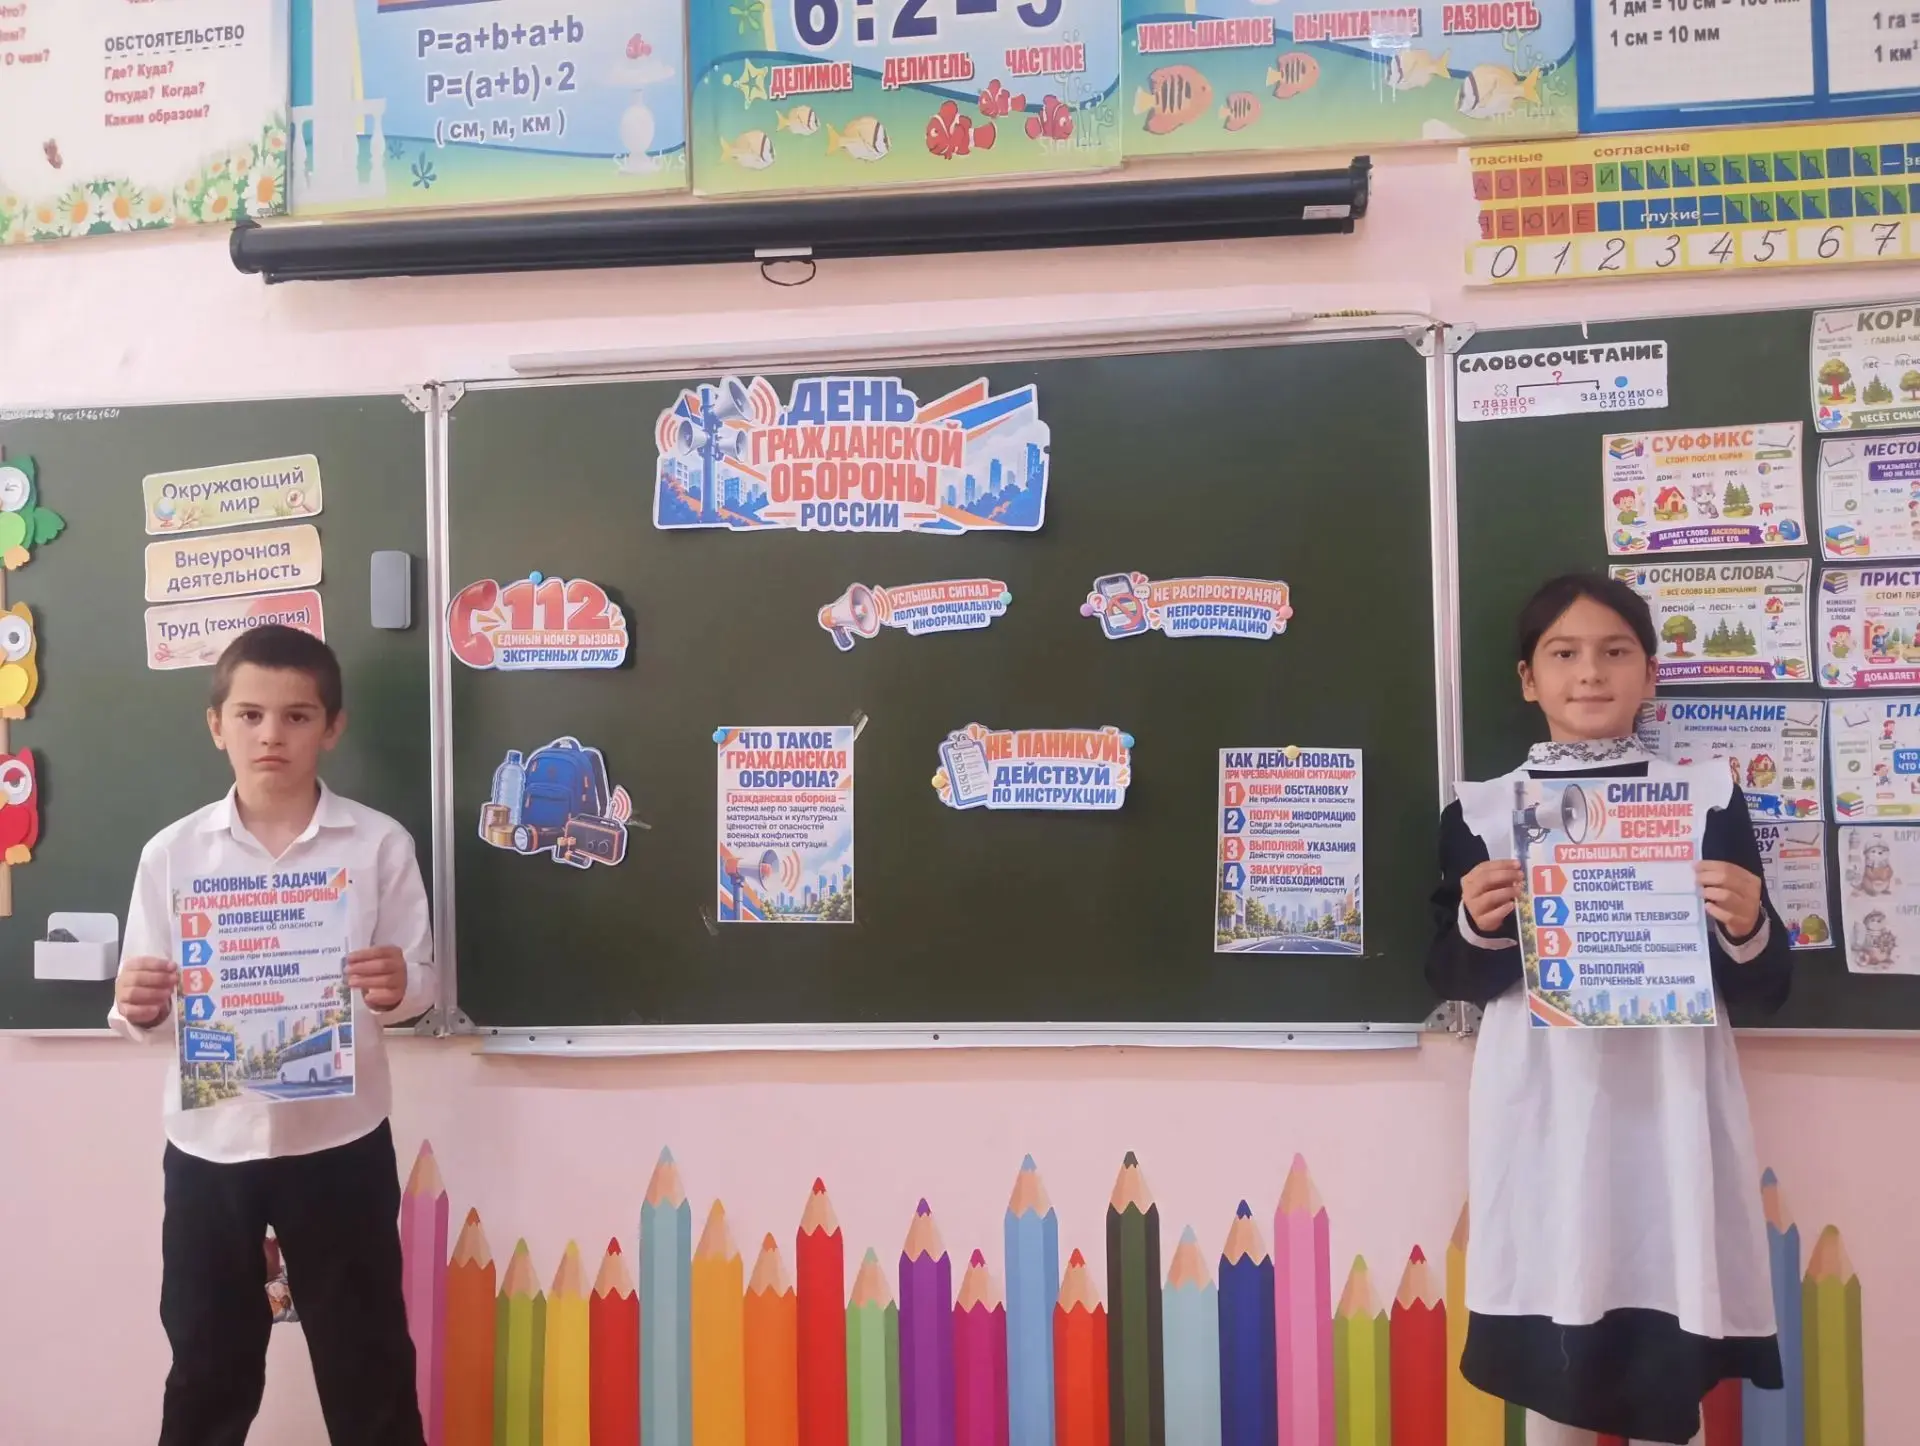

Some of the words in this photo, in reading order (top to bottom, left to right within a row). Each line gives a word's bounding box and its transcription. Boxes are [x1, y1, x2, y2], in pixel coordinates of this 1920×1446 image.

[1138, 18, 1273, 52] УМЕНЬШАЕМОЕ
[1442, 2, 1539, 33] РАЗНОСТЬ
[1873, 12, 1881, 30] 1
[105, 24, 244, 52] ОБСТОЯТЕЛЬСТВО
[1610, 30, 1618, 46] 1
[1625, 32, 1648, 46] см
[1669, 26, 1688, 43] 10
[1695, 28, 1720, 42] мм
[1874, 45, 1883, 62] 1
[104, 66, 133, 79] Где?
[137, 61, 174, 78] Куда?
[770, 62, 852, 96] ДЕЛИМОЕ
[883, 52, 973, 88] ДЕЛИТЕЛЬ
[1005, 45, 1084, 74] ЧАСТНОЕ
[104, 87, 155, 104] Откуда?
[162, 82, 205, 99] Когда?
[105, 114, 144, 126] Каким
[149, 105, 210, 124] образом?
[1470, 152, 1543, 166] гласные
[1594, 143, 1690, 158] согласные
[1641, 210, 1700, 224] глухие
[1491, 245, 1518, 278] 0
[1554, 241, 1571, 274] 1
[1598, 238, 1625, 271] 2
[1656, 235, 1680, 267] 3
[1708, 232, 1733, 263] 4
[1754, 229, 1787, 262] 5
[1818, 226, 1844, 258] 6
[1871, 222, 1900, 255] 7
[1459, 344, 1664, 373] СЛОВОСОЧЕТАНИЕ
[788, 381, 915, 426] ДЕНЬ
[1473, 396, 1535, 409] главное
[1580, 388, 1664, 402] зависимое
[1482, 406, 1527, 417] слово
[1600, 398, 1646, 409] слово
[752, 420, 964, 469] ГРАЖДАНСКОЙ
[1652, 430, 1754, 453] СУФФИКС
[162, 467, 304, 502] Окружающий
[770, 462, 939, 506] ОБОРОНЫ
[220, 496, 260, 514] мир
[800, 502, 899, 527] РОССИИ
[175, 541, 291, 569] Внеурочная
[167, 562, 301, 593] деятельность
[1649, 567, 1716, 583] ОСНОВА
[1720, 565, 1774, 580] СЛОВА
[892, 587, 945, 606] УСЛЫШАЛ
[949, 584, 989, 598] СИГНАЛ
[1154, 588, 1169, 602] НЕ
[1172, 584, 1282, 605] РАСПРОСТРАНЯЙ
[503, 580, 610, 630] 112
[894, 606, 928, 621] ПОЛУЧИ
[931, 600, 1002, 615] ОФИЦИАЛЬНУЮ
[1166, 605, 1272, 621] НЕПРОВЕРЕННУЮ
[1661, 602, 1695, 613] лесной
[158, 622, 200, 640] Труд
[205, 607, 311, 634] (технология)
[912, 613, 986, 630] ИНФОРМАЦИЮ
[1172, 618, 1268, 634] ИНФОРМАЦИЮ
[498, 634, 541, 645] ЕДИНЫЙ
[544, 633, 575, 645] НОМЕР
[578, 633, 620, 645] ВЫЗОВА
[503, 649, 578, 663] ЭКСТРЕННЫХ
[581, 649, 618, 662] СЛУЖБ
[1672, 704, 1786, 720] ОКОНЧАНИЕ
[739, 732, 772, 749] ЧТО
[777, 732, 832, 749] ТАКОЕ
[986, 734, 1012, 761] НЕ
[1018, 731, 1126, 765] ПАНИКУЙ!
[726, 751, 847, 769] ГРАЖДАНСКАЯ
[1225, 753, 1253, 768] КАК
[739, 770, 839, 788] ОБОРОНА?
[994, 762, 1110, 787] ДЕЙСТВУЙ
[1225, 770, 1239, 779] ПРИ
[1241, 769, 1306, 779] ЧРЕЗВЫЧАЙНОЙ
[1307, 770, 1356, 780] СИТУАЦИИ?
[727, 793, 792, 804] Гражданская
[795, 794, 836, 804] оборона
[992, 788, 1011, 803] ПО
[1015, 788, 1116, 805] ИНСТРУКЦИИ
[1228, 786, 1237, 804] 1
[1249, 784, 1281, 796] ОЦЕНИ
[1285, 786, 1349, 795] ОБСТАНОВКУ
[1607, 782, 1689, 803] СИГНАЛ
[1227, 811, 1238, 830] 2
[1250, 810, 1289, 820] ПОЛУЧИ
[1292, 811, 1356, 821] ИНФОРМАЦИЮ
[1608, 804, 1693, 818] «ВНИМАНИЕ
[1621, 820, 1692, 838] ВСЕМ!»
[1226, 840, 1238, 859] 3
[1249, 839, 1304, 851] ВЫПОЛНЯЙ
[1307, 842, 1356, 852] УКАЗАНИЯ
[1560, 846, 1628, 861] УСЛЫШАЛ
[1631, 845, 1690, 858] СИГНАЛ?
[193, 875, 268, 893] ОСНОВНЫЕ
[272, 871, 327, 888] ЗАДАЧИ
[1226, 866, 1239, 887] 4
[1250, 864, 1322, 875] ЭВАКУИРУЙСЯ
[1269, 877, 1345, 886] НЕОБХОДИМОСТИ
[1541, 869, 1552, 892] 1
[1572, 866, 1636, 881] СОХРАНЯЙ
[1573, 880, 1654, 892] СПОКОЙСТВИЕ
[184, 890, 278, 910] ГРАЖДАНСКОЙ
[282, 888, 338, 904] ОБОРОНЫ
[188, 916, 198, 936] 1
[218, 908, 305, 926] ОПОВЕЩЕНИЕ
[1542, 900, 1558, 924] 2
[1575, 900, 1624, 911] ВКЛЮЧИ
[1576, 912, 1609, 923] РАДИО
[1611, 912, 1632, 922] ИЛИ
[1635, 911, 1690, 921] ТЕЛЕВИЗОР
[189, 942, 201, 963] 2
[219, 936, 280, 953] ЗАЩИТА
[1544, 931, 1559, 955] 3
[1577, 928, 1651, 942] ПРОСЛУШАЙ
[1578, 944, 1642, 954] ОФИЦИАЛЬНОЕ
[1644, 943, 1698, 953] СООБЩЕНИЕ
[189, 970, 202, 991] 3
[220, 963, 300, 981] ЭВАКУАЦИЯ
[1547, 963, 1563, 987] 4
[1579, 961, 1644, 975] ВЫПОЛНЯЙ
[1580, 976, 1643, 986] ПОЛУЧЕННЫЕ
[1645, 976, 1696, 985] УКАЗАНИЯ
[191, 999, 204, 1019] 4
[221, 991, 285, 1008] ПОМОЩЬ
